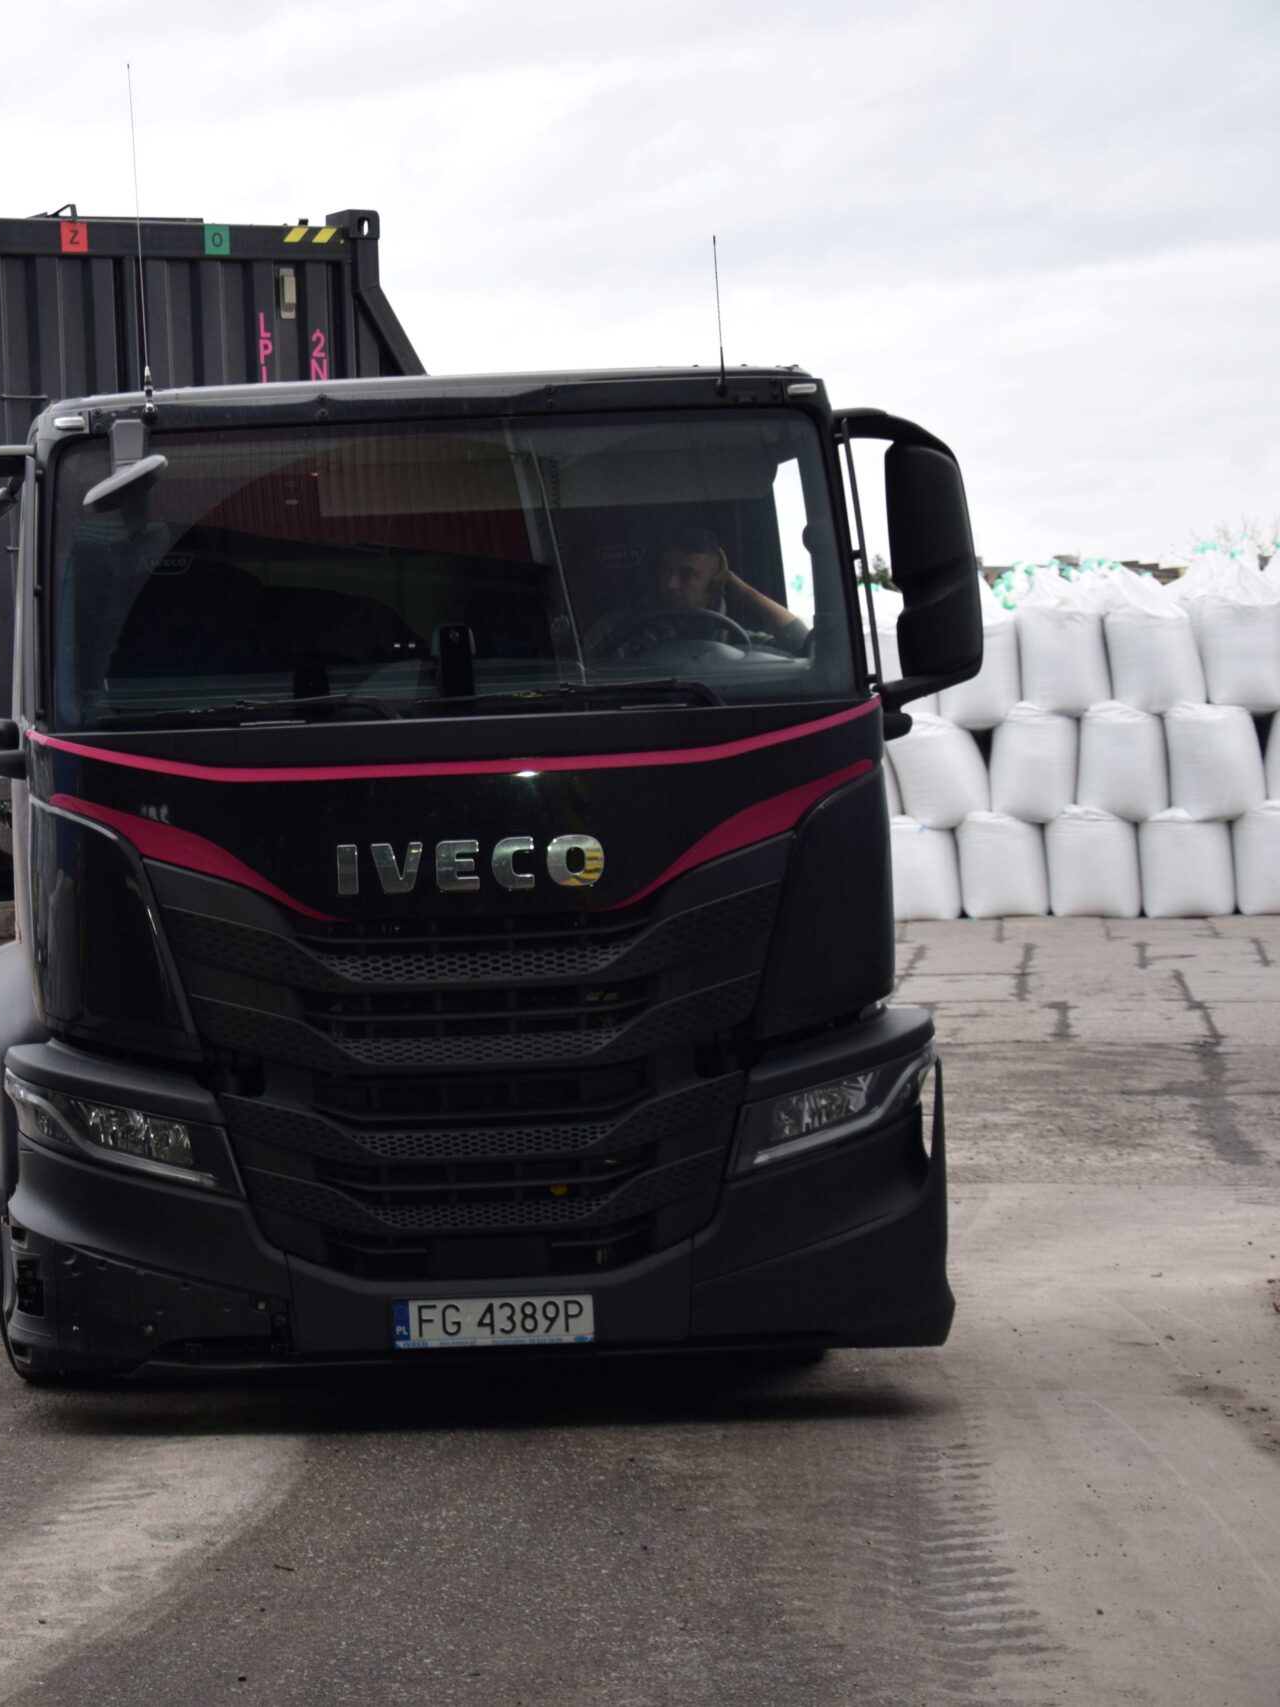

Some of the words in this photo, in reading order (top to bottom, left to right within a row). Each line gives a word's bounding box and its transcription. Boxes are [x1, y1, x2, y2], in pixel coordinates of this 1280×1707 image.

[69, 229, 80, 245] Z
[336, 834, 605, 896] IVECO
[396, 1326, 408, 1336] PL
[417, 1304, 462, 1337] FG
[477, 1300, 584, 1335] 4389P
